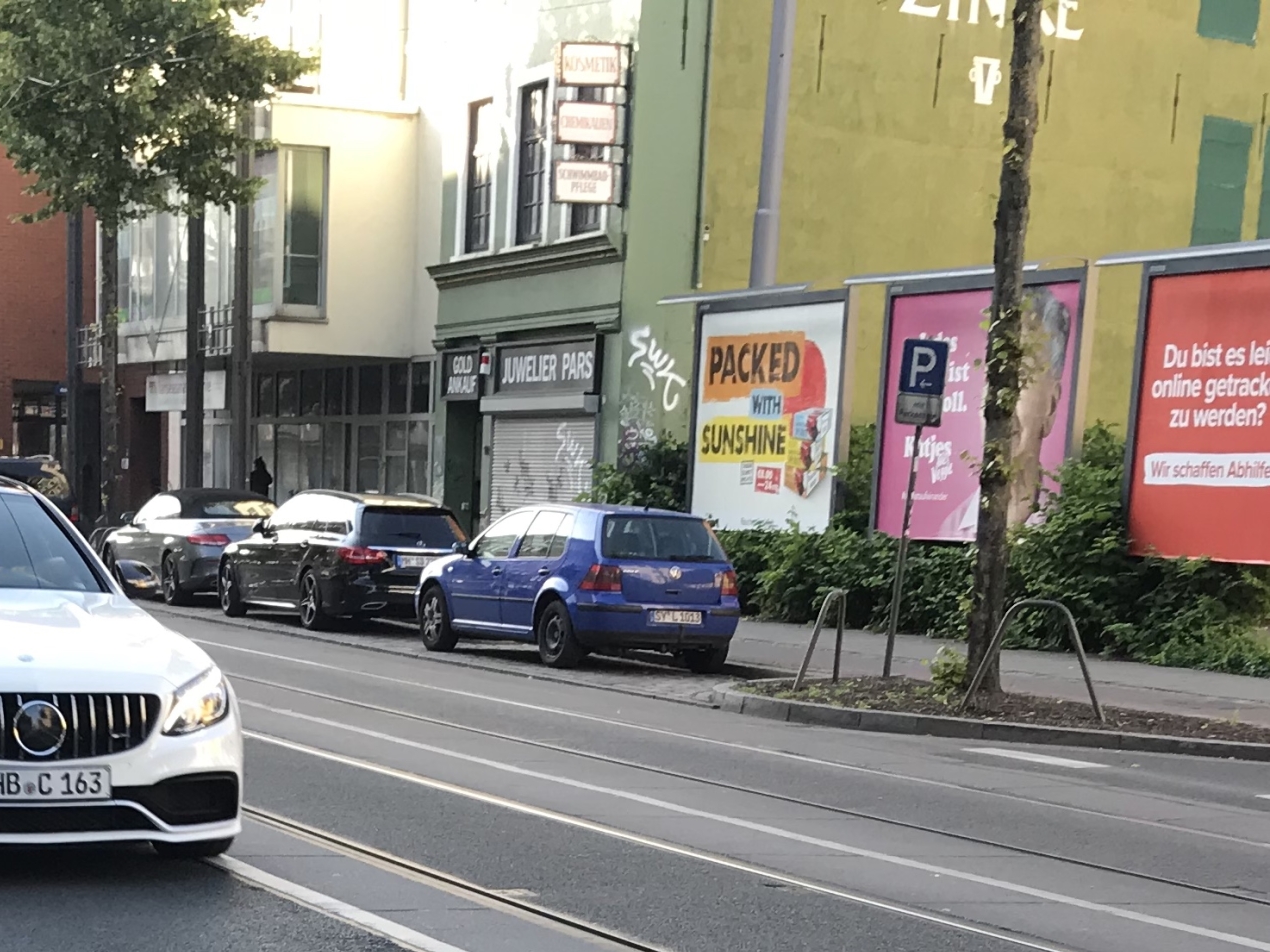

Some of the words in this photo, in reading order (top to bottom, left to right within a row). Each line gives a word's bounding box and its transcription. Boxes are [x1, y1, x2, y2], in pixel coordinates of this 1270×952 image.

[564, 56, 617, 73] KOSMETIK
[570, 182, 597, 193] PFLEGE
[453, 355, 473, 375] GOLD
[502, 354, 557, 384] JUWELIER
[561, 350, 593, 381] PARS
[708, 341, 801, 385] PACKED
[909, 346, 937, 388] P
[1163, 344, 1189, 369] Du
[1191, 342, 1223, 368] bist
[1225, 346, 1246, 367] es
[948, 361, 971, 383] ist
[447, 375, 477, 394] ANKAUF
[1151, 372, 1201, 398] online
[751, 395, 781, 415] WITH
[942, 391, 968, 413] oll.
[1169, 408, 1190, 428] zu
[1193, 402, 1268, 427] werden?
[701, 423, 787, 455] SUNSHINE
[1151, 460, 1171, 478] Wir
[1172, 460, 1224, 478] schaffen
[38, 772, 52, 796] C
[60, 772, 102, 796] 163
